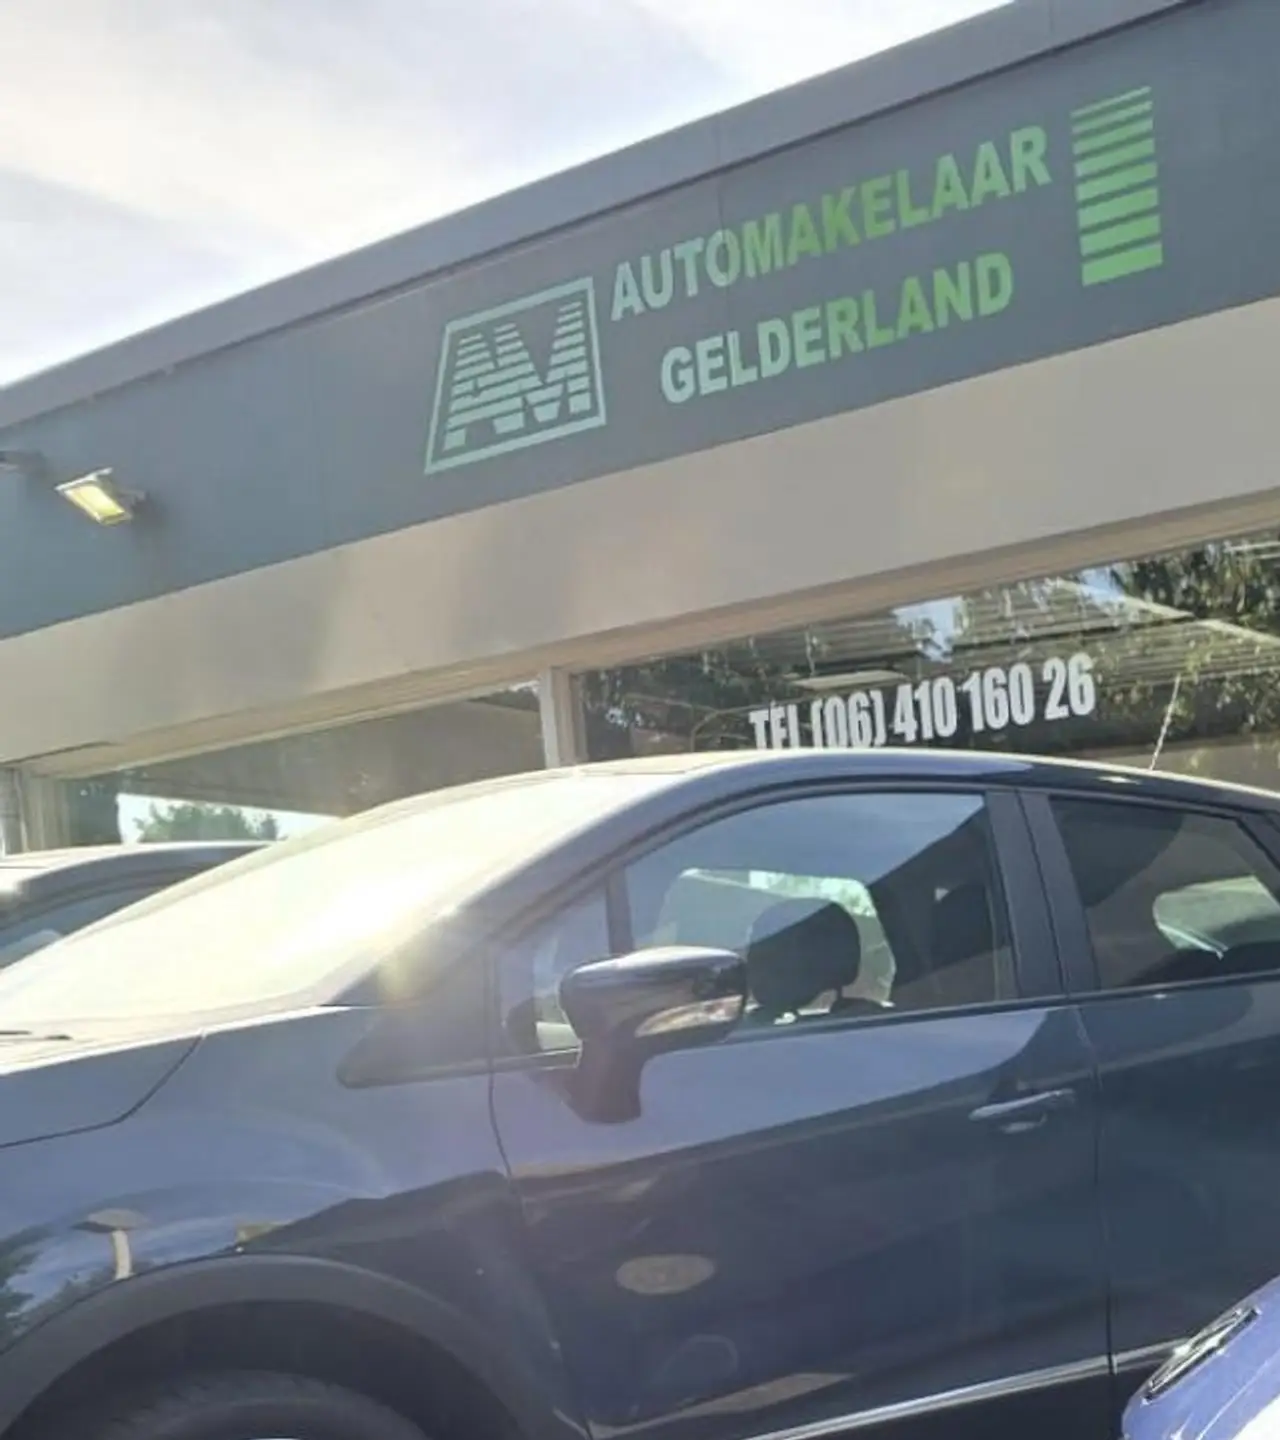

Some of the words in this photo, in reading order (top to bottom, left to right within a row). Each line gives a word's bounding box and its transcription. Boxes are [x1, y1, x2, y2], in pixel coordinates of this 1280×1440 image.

[610, 124, 1053, 322] AUTOMAKELAAR
[440, 299, 593, 454] AM
[660, 253, 1015, 405] GELDERLAND
[810, 688, 888, 751] (06)
[893, 675, 958, 744] 410
[960, 661, 1036, 733] 160
[1042, 651, 1096, 721] 26
